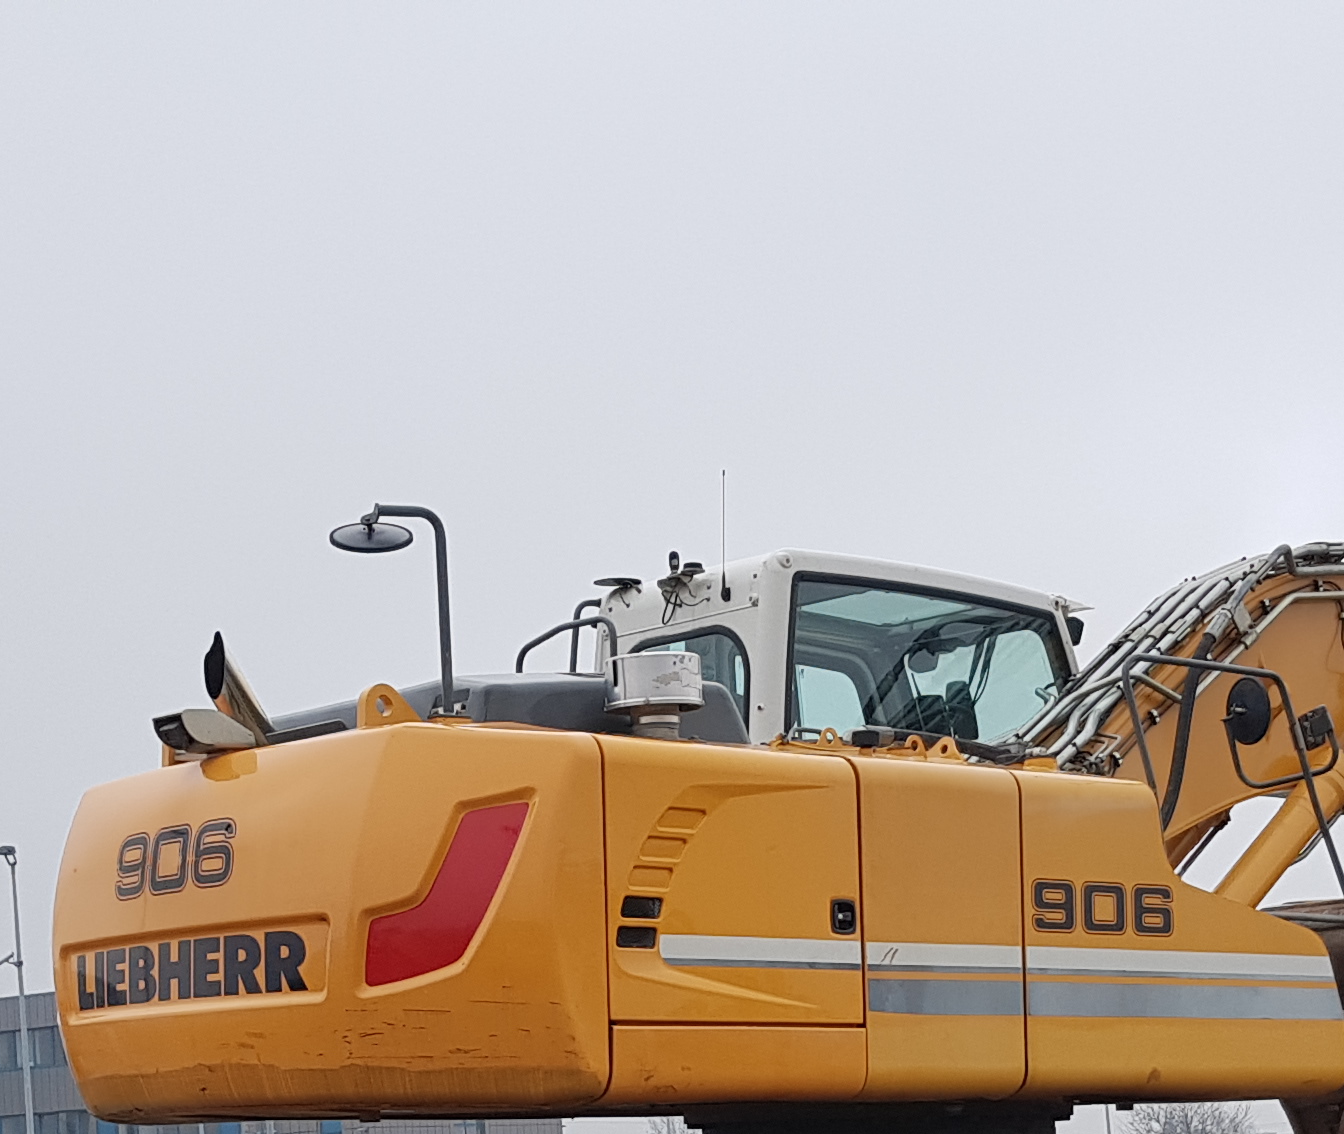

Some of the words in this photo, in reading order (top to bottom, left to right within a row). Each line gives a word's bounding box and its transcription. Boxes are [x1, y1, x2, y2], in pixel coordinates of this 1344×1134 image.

[115, 817, 237, 901] 906
[1031, 878, 1174, 937] 906
[76, 931, 309, 1012] LIEBHERR
